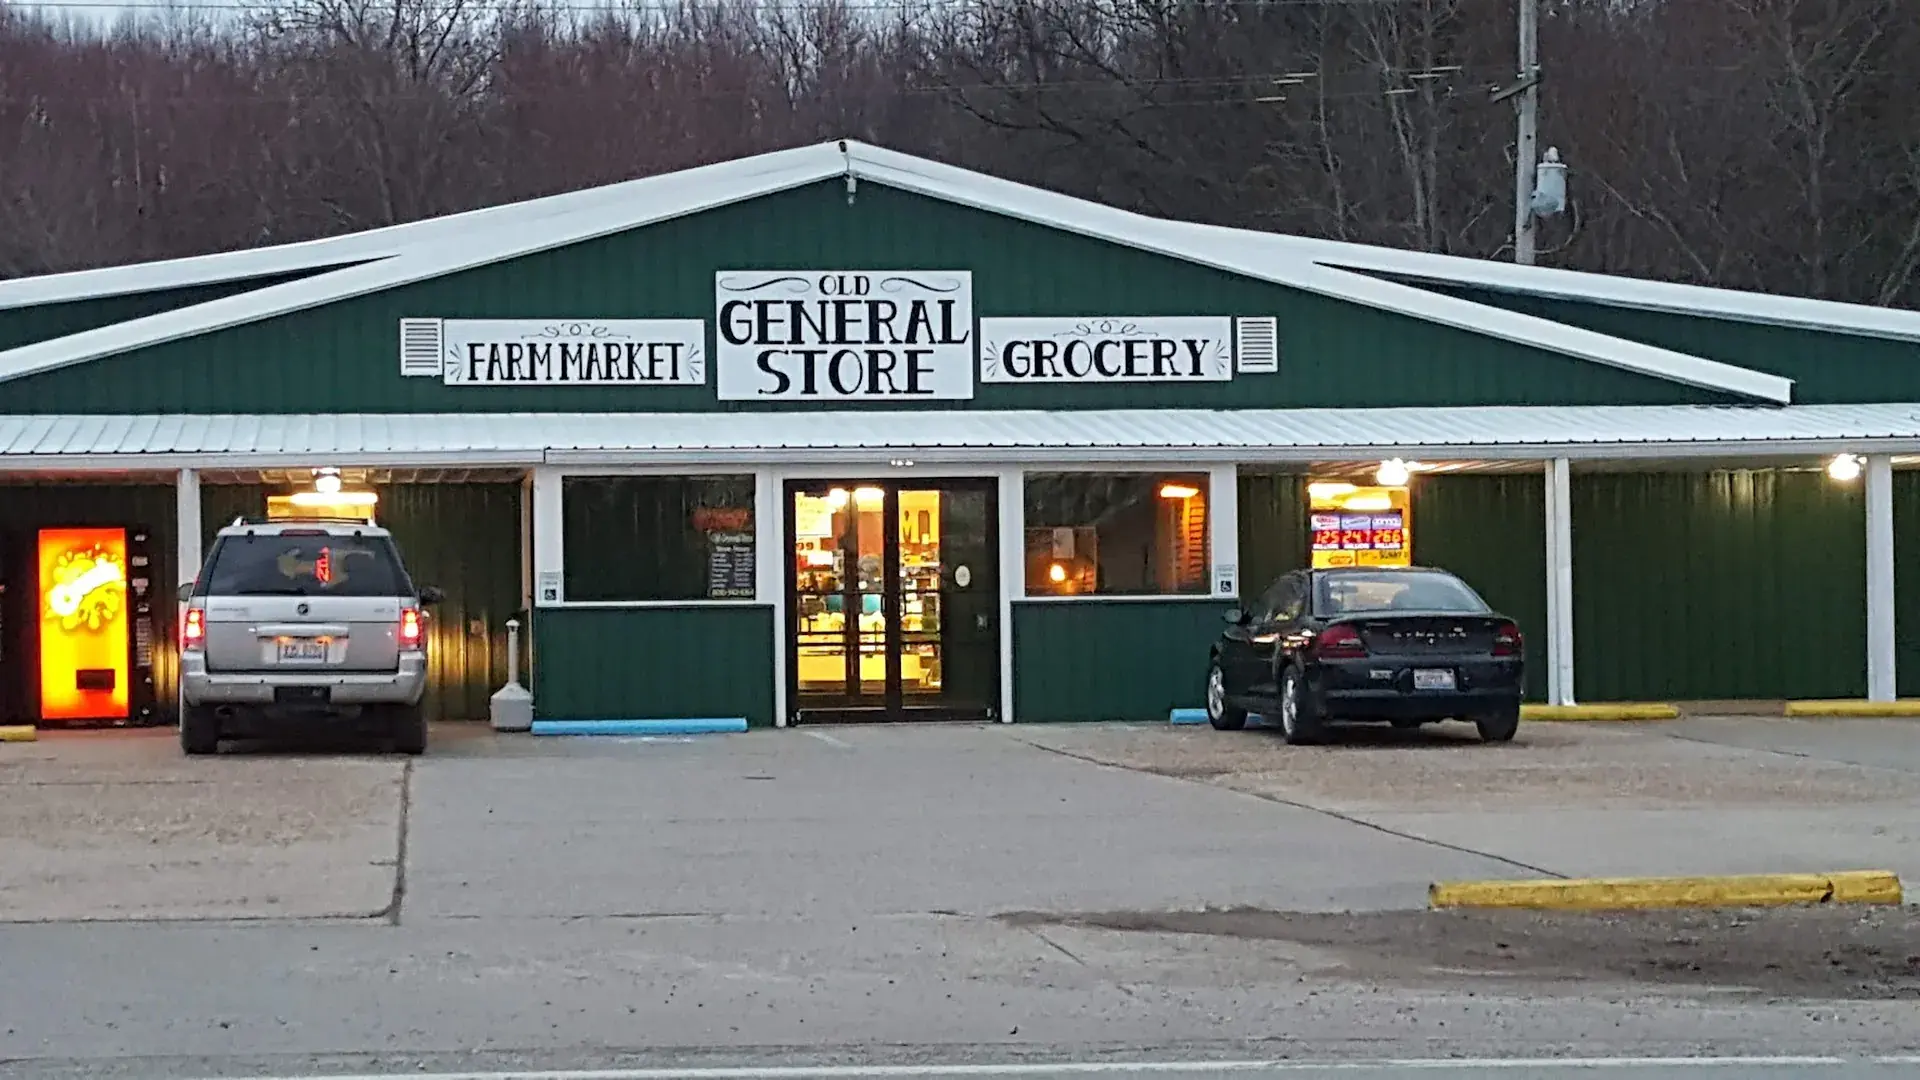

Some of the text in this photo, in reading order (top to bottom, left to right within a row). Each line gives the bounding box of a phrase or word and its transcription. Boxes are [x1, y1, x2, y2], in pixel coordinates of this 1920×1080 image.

[819, 275, 870, 296] OLD
[720, 300, 969, 345] GENERAL
[467, 342, 685, 381] FARM MARKET
[756, 349, 935, 395] STORE
[1002, 339, 1210, 378] GROCERY
